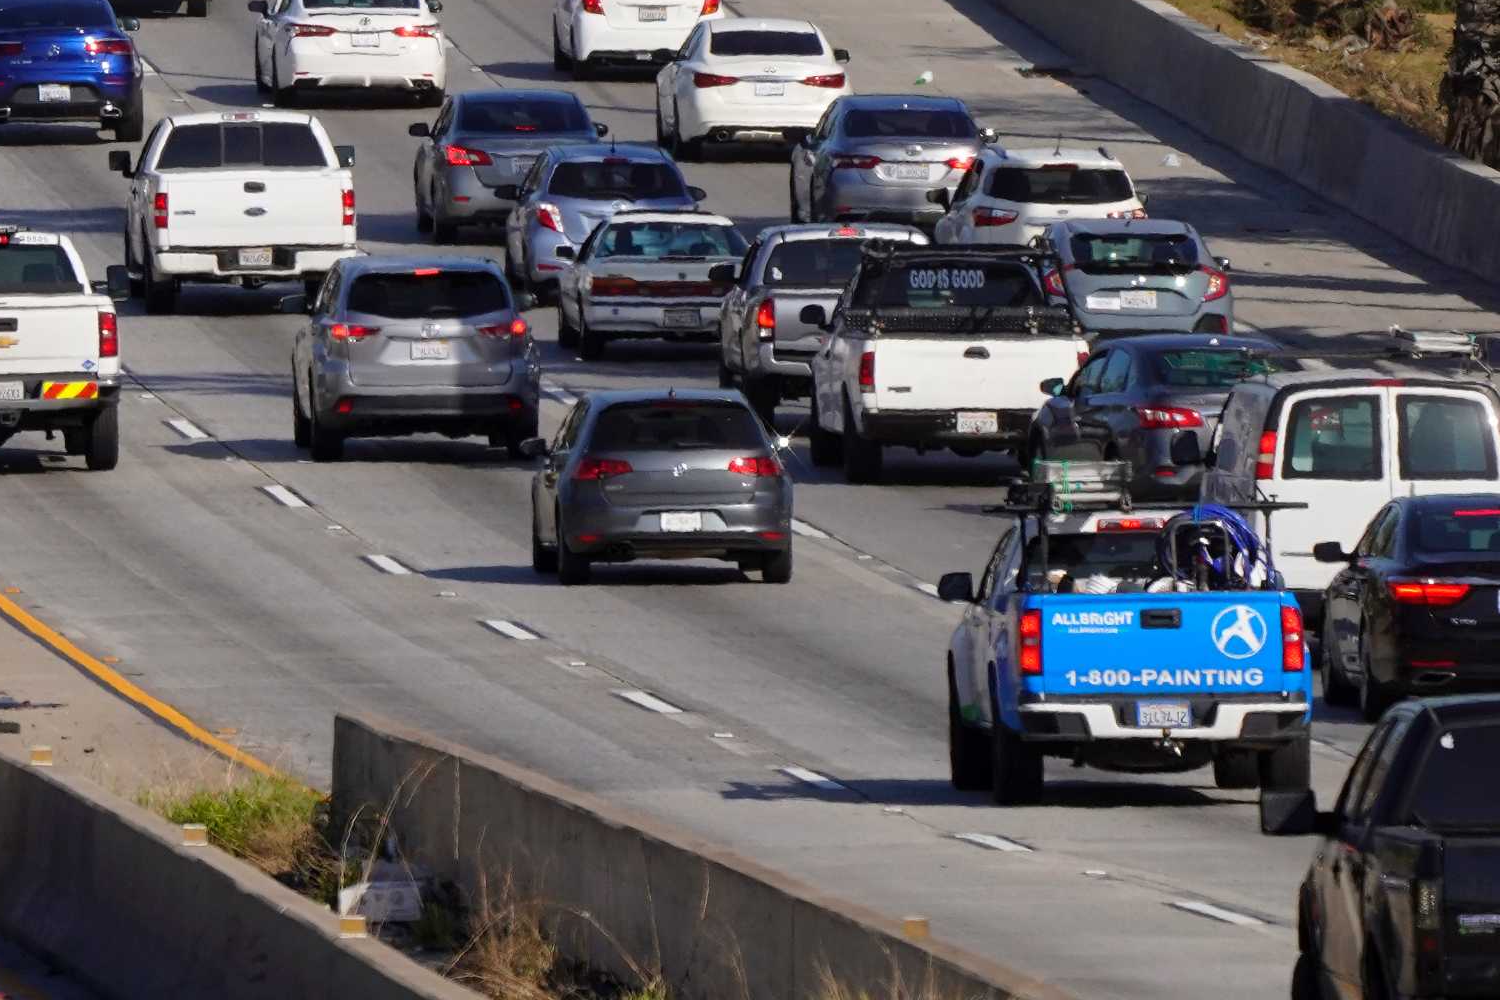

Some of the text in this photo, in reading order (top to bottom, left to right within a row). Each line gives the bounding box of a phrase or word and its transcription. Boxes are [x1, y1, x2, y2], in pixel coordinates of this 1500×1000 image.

[909, 268, 985, 289] GOD IS GOOD
[1064, 668, 1264, 687] 1-800-PAINTING
